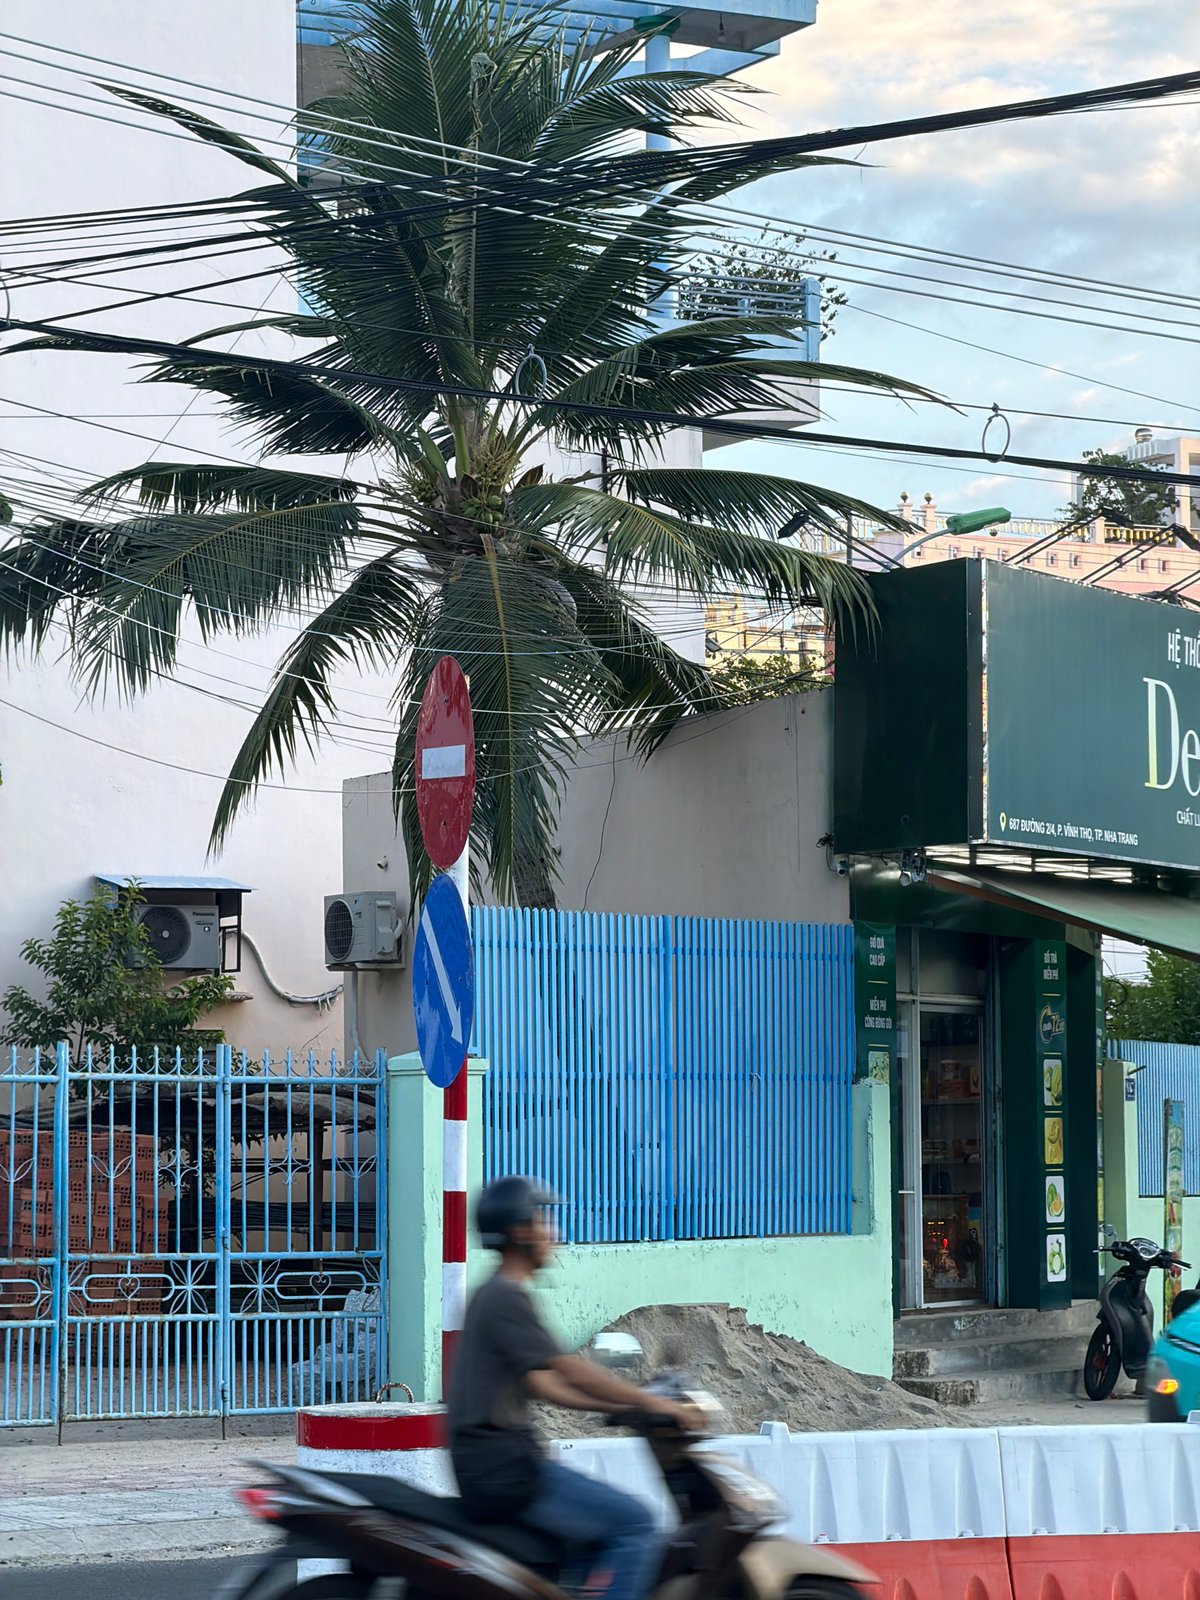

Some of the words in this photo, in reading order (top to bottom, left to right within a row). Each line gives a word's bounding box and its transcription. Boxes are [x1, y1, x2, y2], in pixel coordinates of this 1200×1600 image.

[1168, 628, 1181, 669] HỆ
[1009, 817, 1020, 831] 687
[1020, 817, 1045, 834] ĐƯỜNG
[1057, 824, 1063, 836] P.
[1063, 822, 1079, 838] VĨNH
[1094, 828, 1104, 841] TP.
[1104, 830, 1117, 843] NHA
[1117, 831, 1138, 846] TRANG
